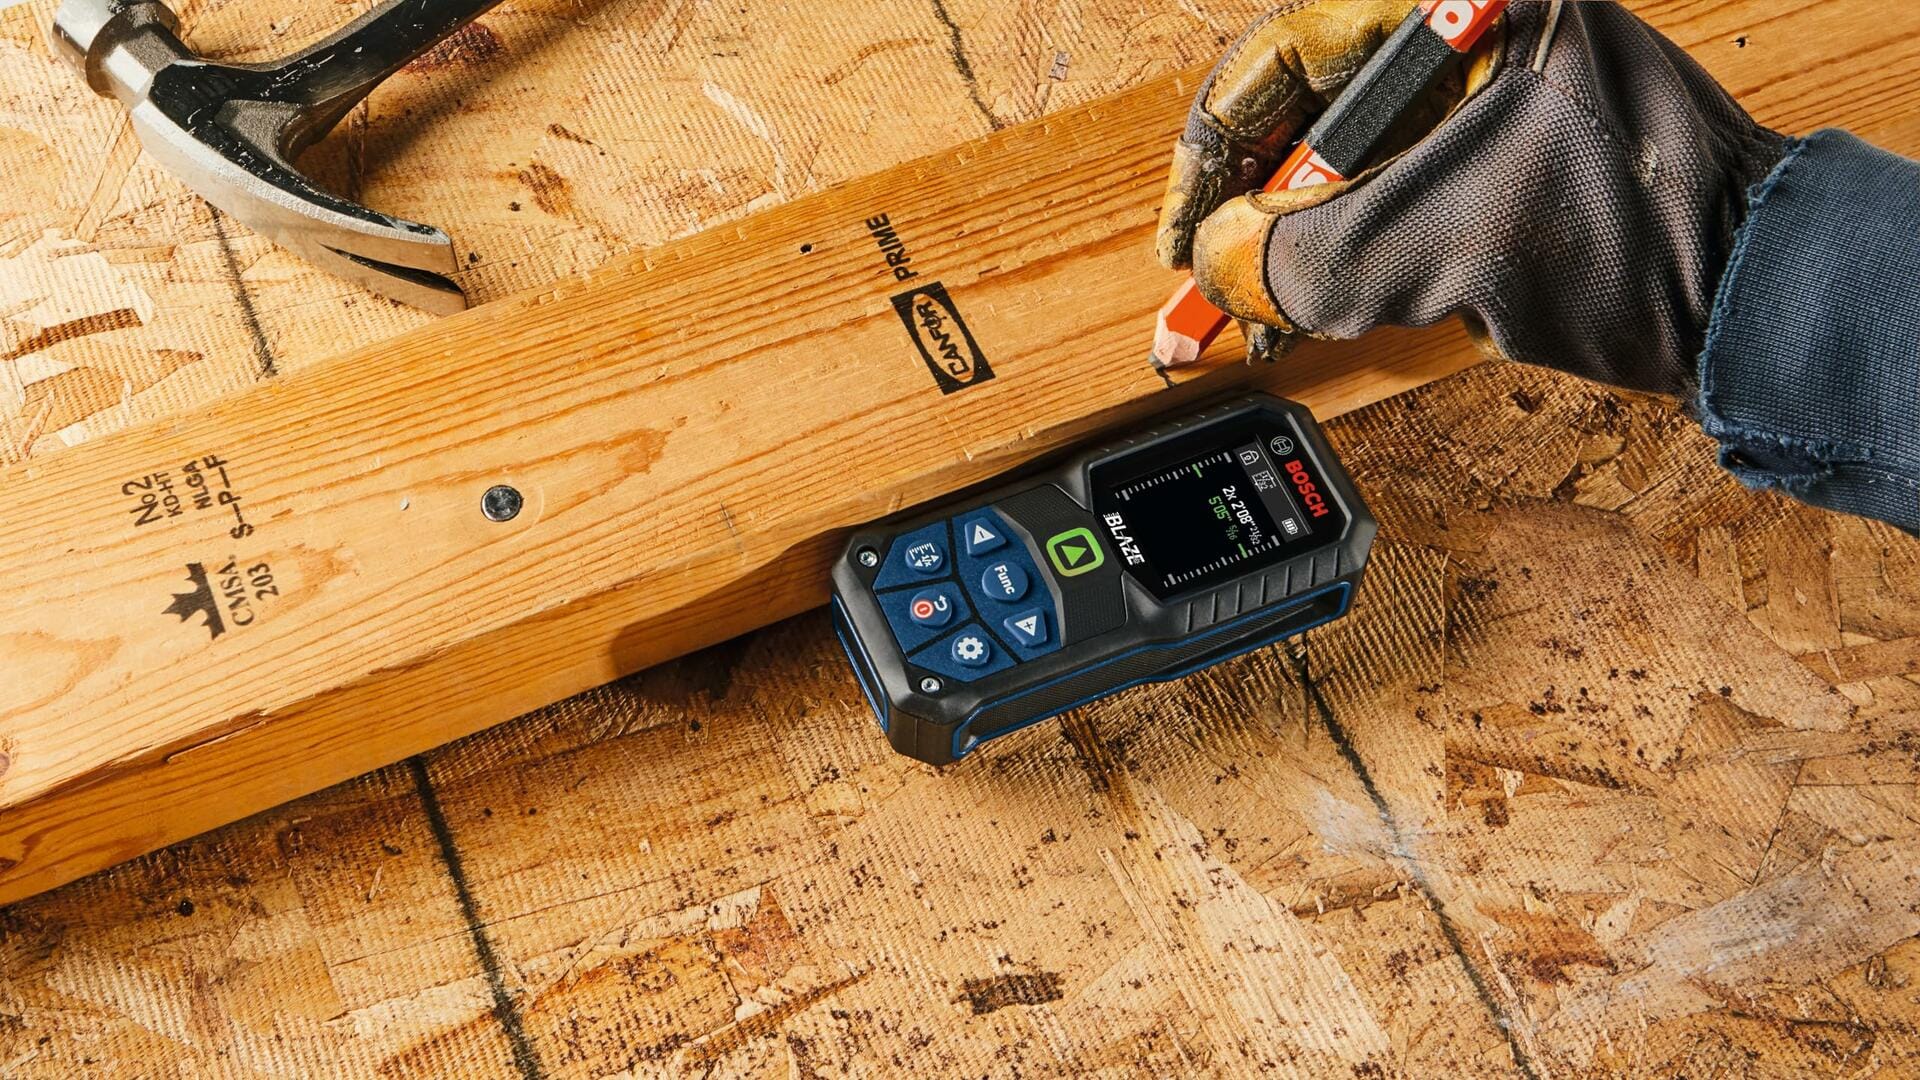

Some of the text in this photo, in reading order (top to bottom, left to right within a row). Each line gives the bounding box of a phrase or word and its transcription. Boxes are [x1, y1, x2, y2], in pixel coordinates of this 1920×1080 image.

[866, 213, 918, 281] PRIME
[918, 301, 970, 376] CANFOR
[153, 472, 183, 518] KD-HT
[182, 460, 213, 510] NLGA
[1285, 460, 1329, 517] BOSCH
[1104, 511, 1145, 565] BLAZE
[247, 563, 279, 601] 203
[994, 564, 1015, 594] Func
